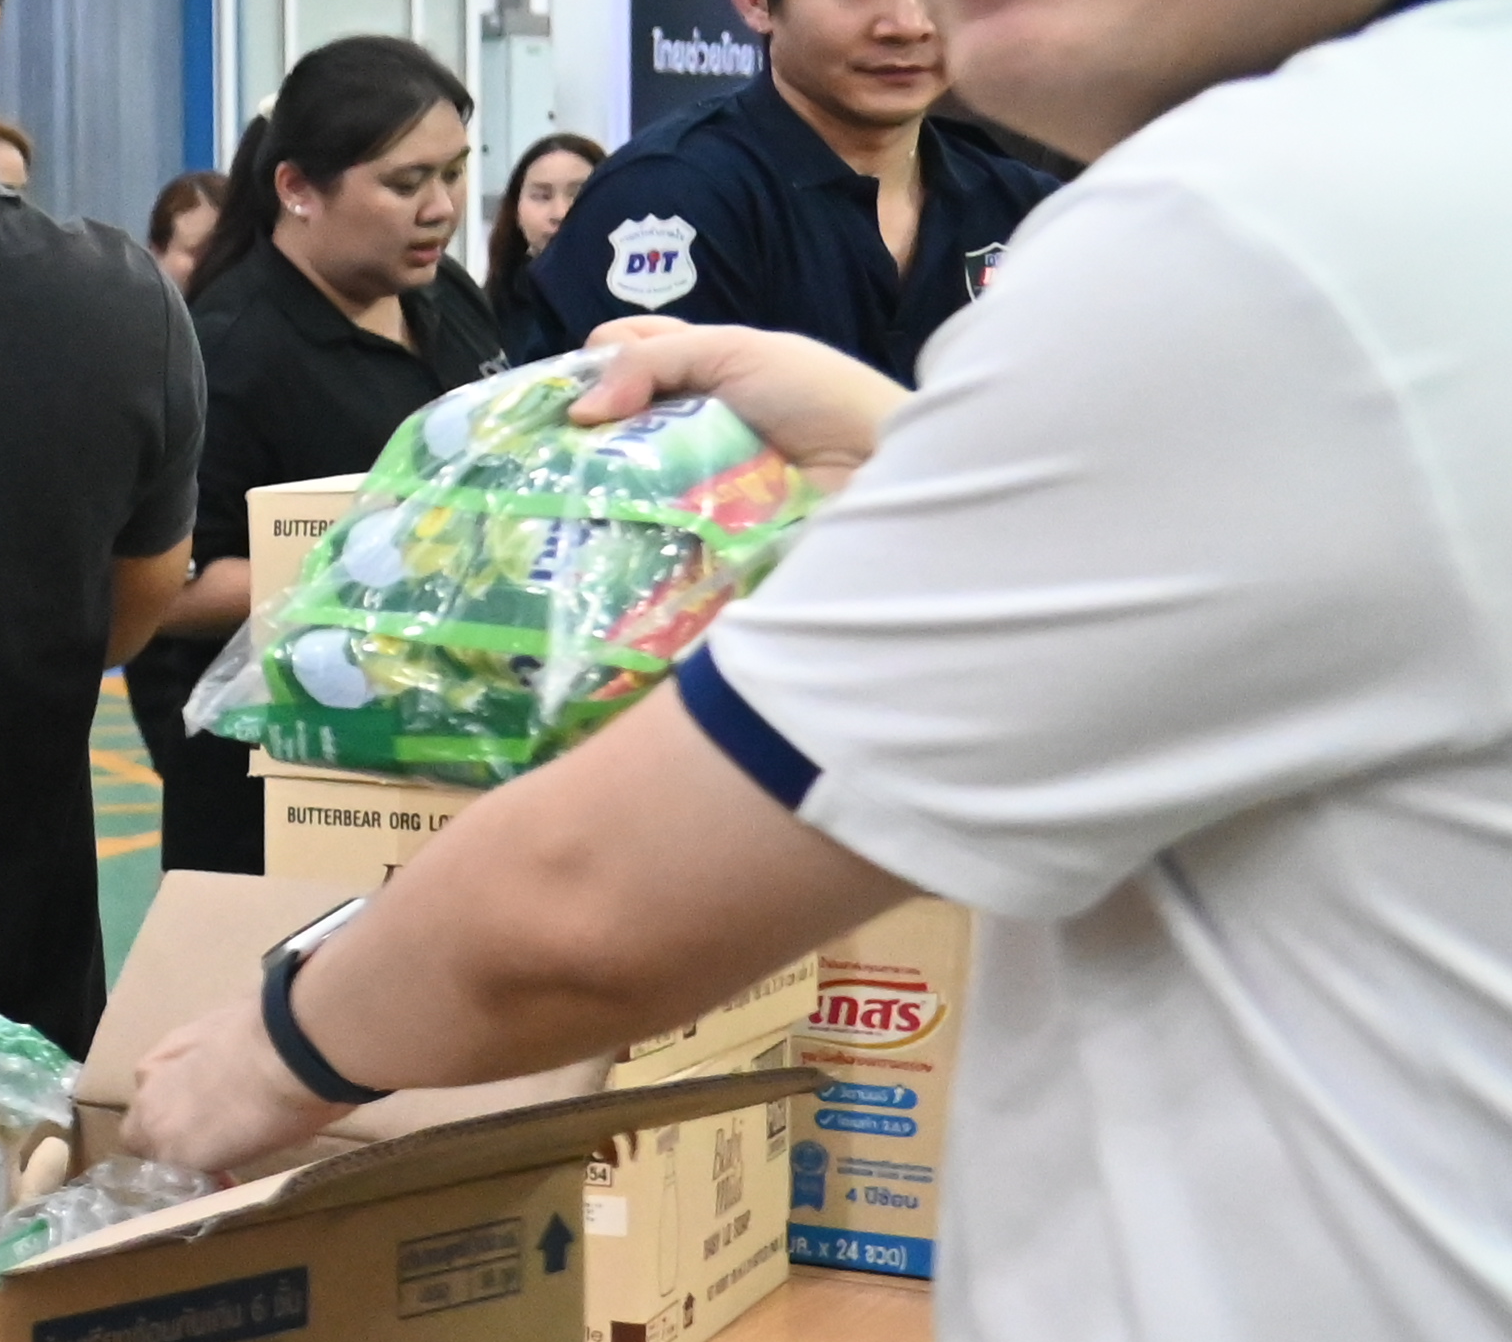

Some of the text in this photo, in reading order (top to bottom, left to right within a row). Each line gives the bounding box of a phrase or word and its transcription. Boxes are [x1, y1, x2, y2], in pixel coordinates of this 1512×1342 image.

[273, 517, 334, 538] BUTTER
[287, 806, 381, 829] BUTTERBEAR
[389, 811, 422, 831] ORG
[835, 1238, 859, 1261] 24
